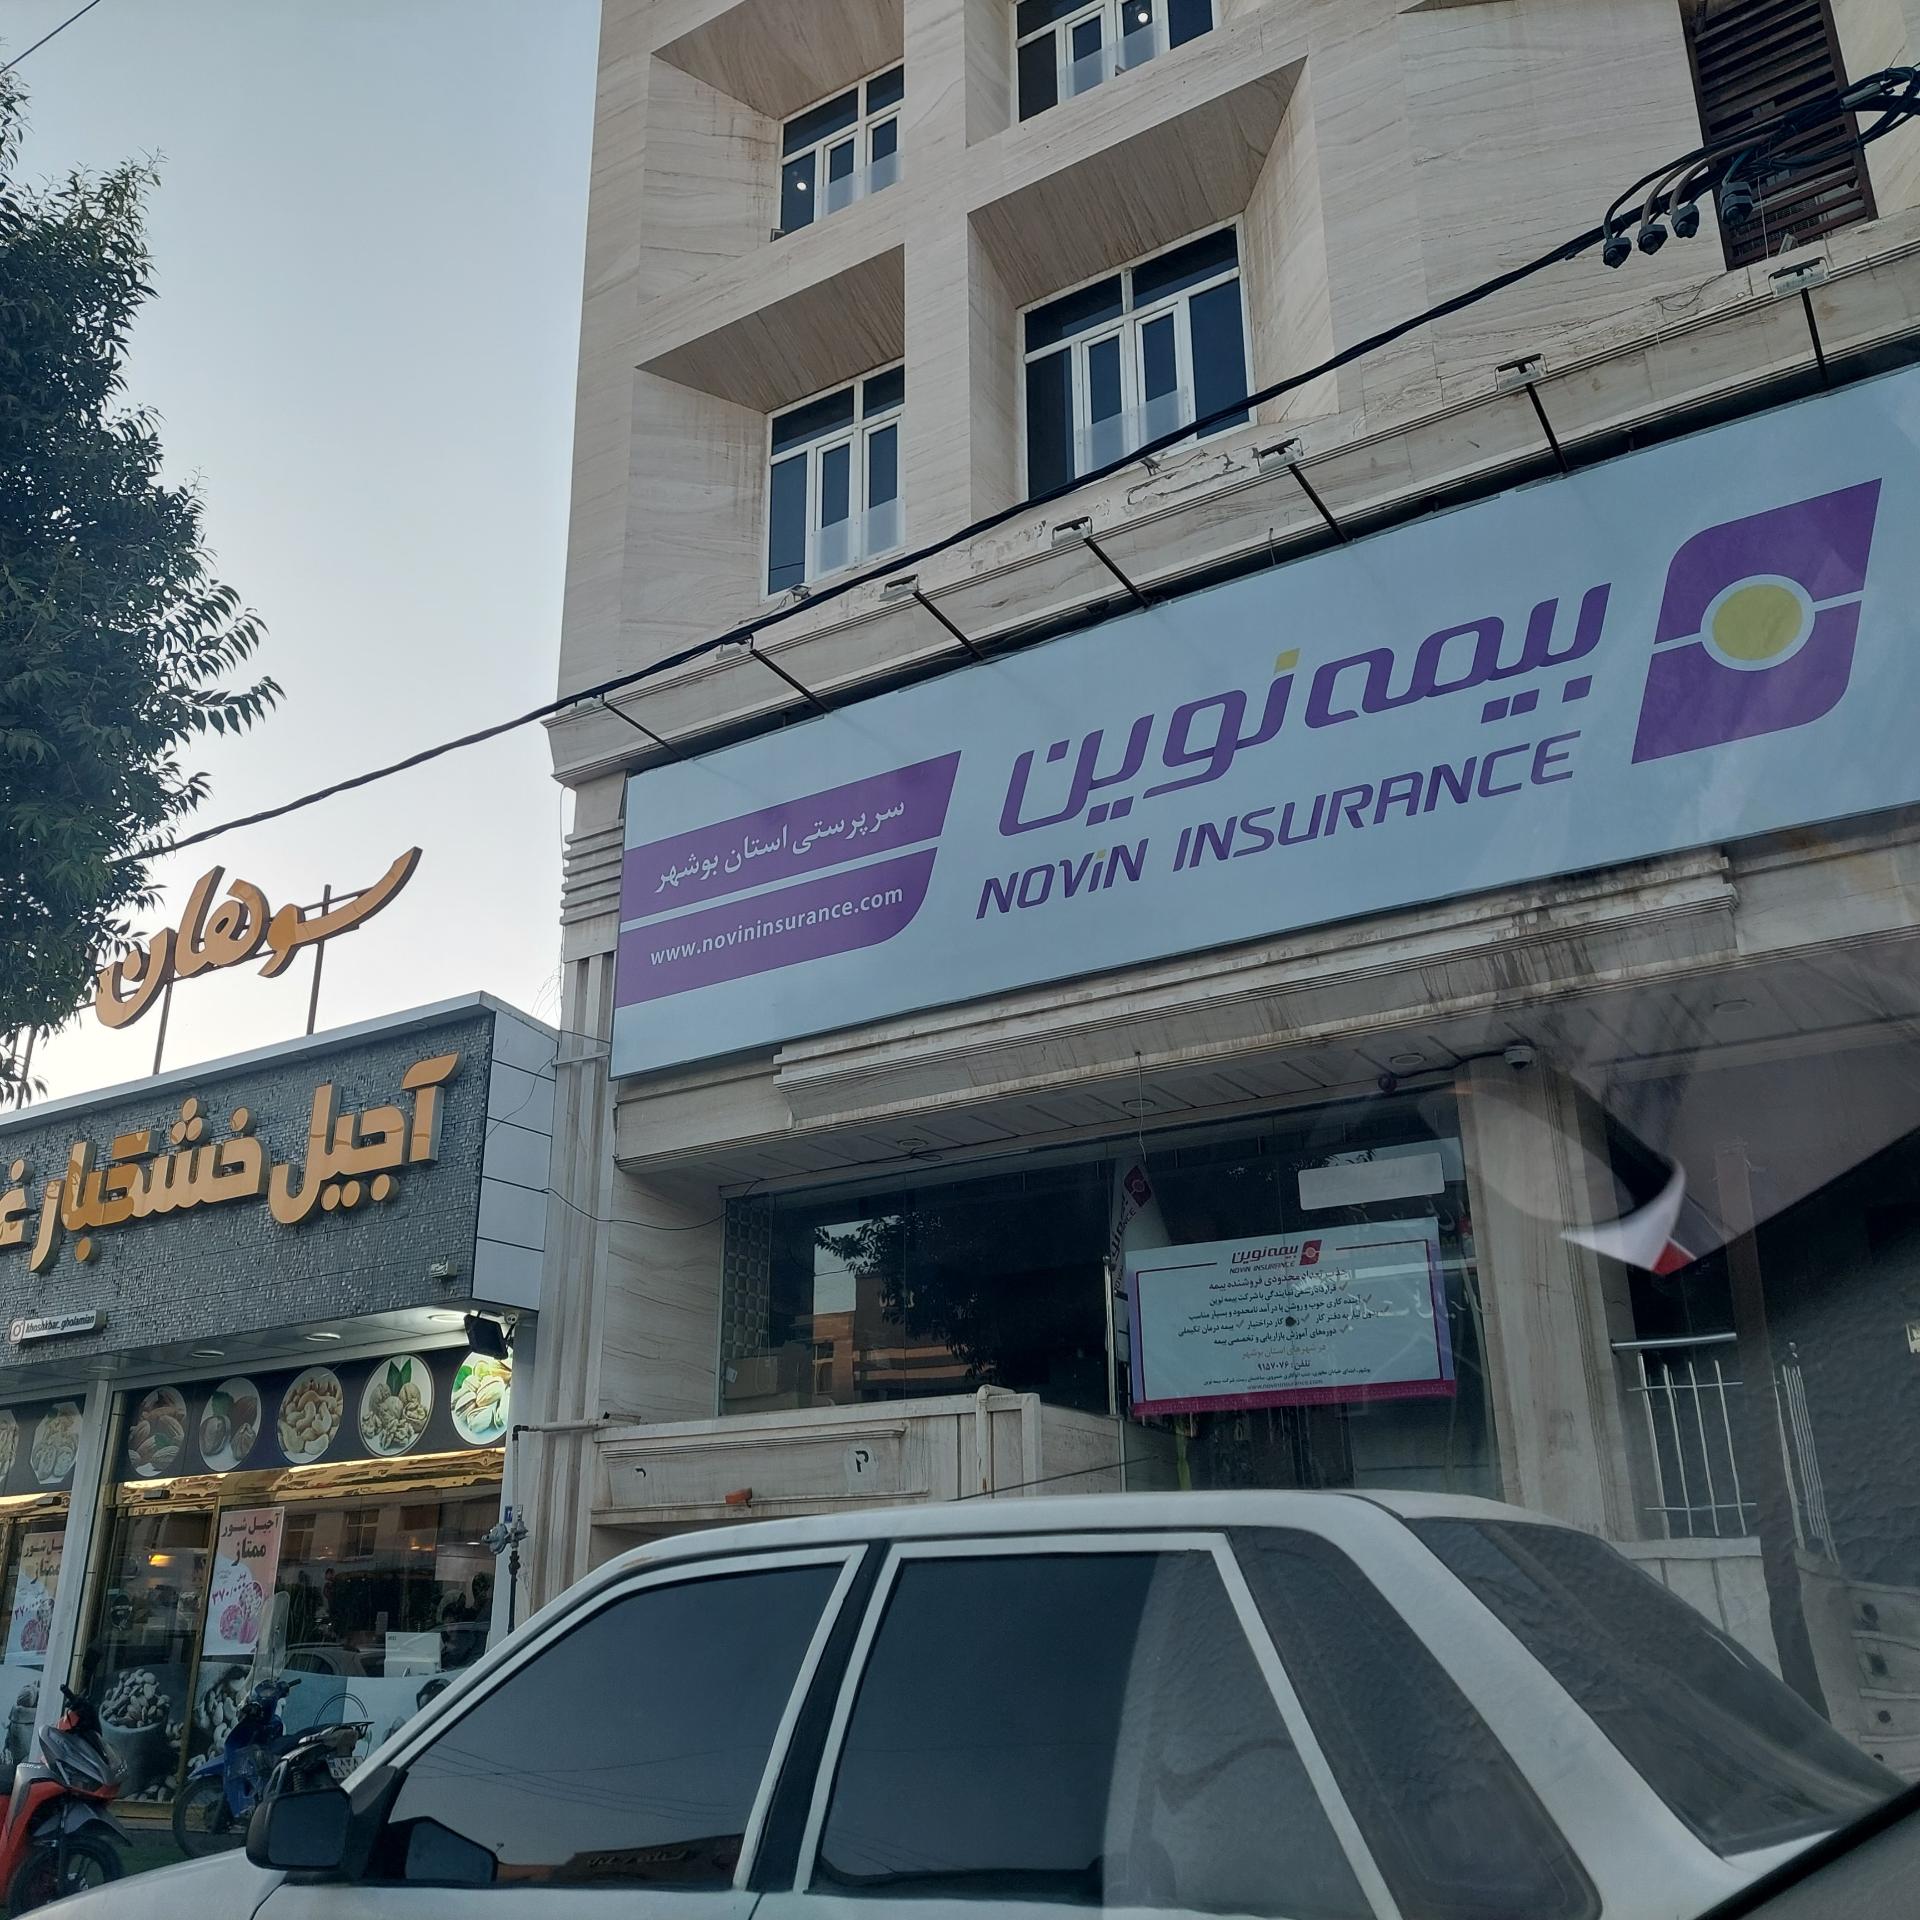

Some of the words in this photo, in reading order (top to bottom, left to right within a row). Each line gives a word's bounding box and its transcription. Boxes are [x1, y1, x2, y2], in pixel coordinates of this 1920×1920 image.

[1304, 582, 1612, 729] بیمه
[998, 647, 1301, 837] نوین
[1172, 730, 1582, 873] INSURANCE
[725, 824, 788, 873] استان
[654, 853, 720, 893] بوشهر
[650, 885, 904, 966] www.novininsurance.com
[95, 846, 423, 1029] سوهان
[268, 1053, 462, 1225] آجیل
[30, 1096, 268, 1273] خشکبار
[1231, 1246, 1268, 1265] نوین
[1268, 1245, 1299, 1259] بیمه
[1253, 1261, 1296, 1272] INSURANCE
[1226, 1277, 1262, 1289] فروشنده
[1264, 1274, 1300, 1287] محدودی
[1209, 1283, 1226, 1291] بیمه
[1238, 1291, 1258, 1302] شرکت
[1265, 1289, 1294, 1301] نمایندگی
[1209, 1298, 1224, 1306] نوین
[1285, 1303, 1303, 1313] روشن
[1309, 1301, 1324, 1310] خوب
[1326, 1298, 1341, 1308] کاری
[1211, 1310, 1227, 1319] بسیار
[1233, 1306, 1257, 1317] نامحدود
[1258, 1303, 1278, 1314] درآمد
[1188, 1312, 1210, 1320] مناسب
[1316, 1313, 1324, 1323] کار
[1327, 1312, 1340, 1323] دفتر
[1351, 1310, 1360, 1320] نیاز
[1275, 1317, 1284, 1327] کار
[1201, 1323, 1220, 1334] درمان
[1287, 1328, 1308, 1340] آموزش
[1227, 1335, 1254, 1345] تخصصی
[1259, 1331, 1285, 1343] بازاریابی
[221, 1517, 248, 1538] شور
[248, 1513, 281, 1535] آجیل
[24, 1540, 47, 1557] شور
[231, 1537, 267, 1567] ممتاز
